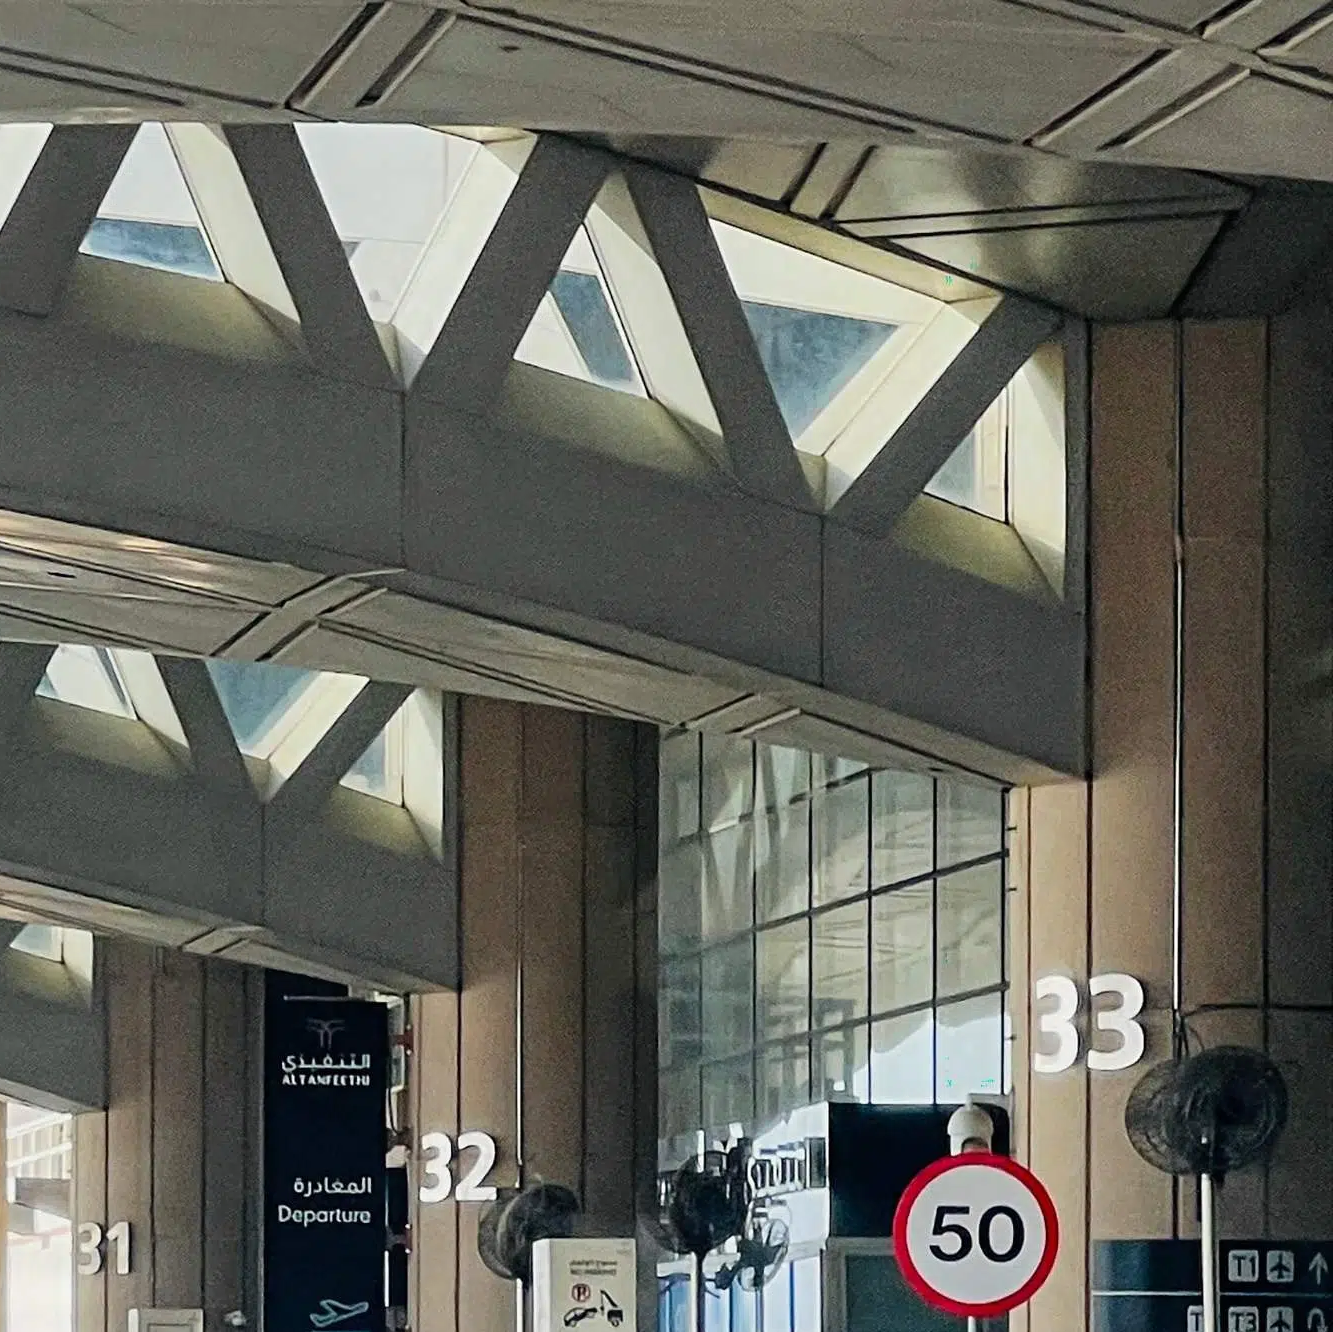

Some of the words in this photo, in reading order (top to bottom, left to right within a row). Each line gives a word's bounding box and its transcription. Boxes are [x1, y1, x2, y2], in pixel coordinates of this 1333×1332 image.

[1033, 973, 1145, 1073] 33
[281, 1053, 371, 1072] التنفيذي
[419, 1131, 498, 1203] 32
[293, 1176, 372, 1198] المغادرة
[277, 1205, 372, 1228] Departure
[929, 1205, 1025, 1263] 50
[77, 1221, 131, 1275] 31
[1232, 1254, 1257, 1278] T1
